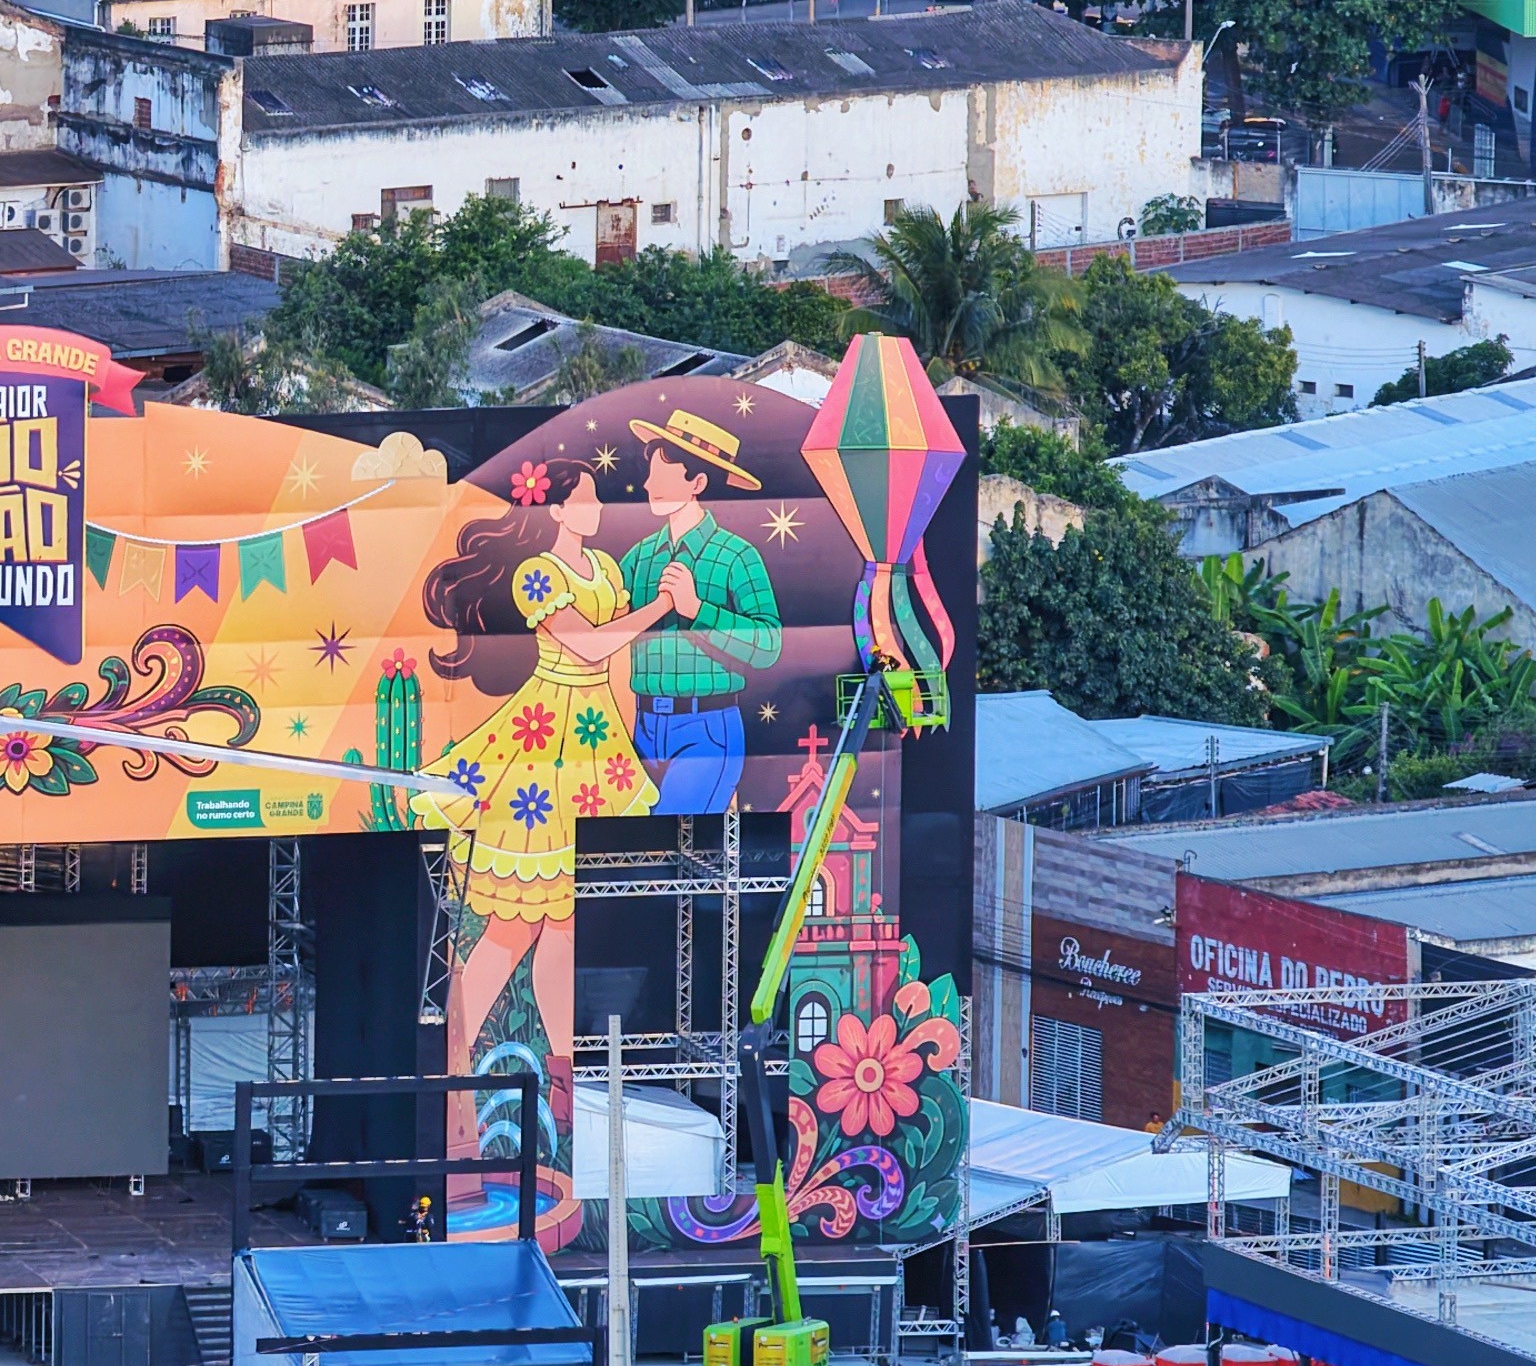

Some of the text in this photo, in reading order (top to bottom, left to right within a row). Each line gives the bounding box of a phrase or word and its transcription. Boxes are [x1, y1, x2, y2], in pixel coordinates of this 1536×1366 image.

[6, 338, 100, 376] GRANDE
[195, 799, 304, 811] Trabalhando CAMPINA
[196, 809, 304, 820] no rumo certo GRANDE
[1190, 934, 1386, 1019] OFICINA DO PEDRO
